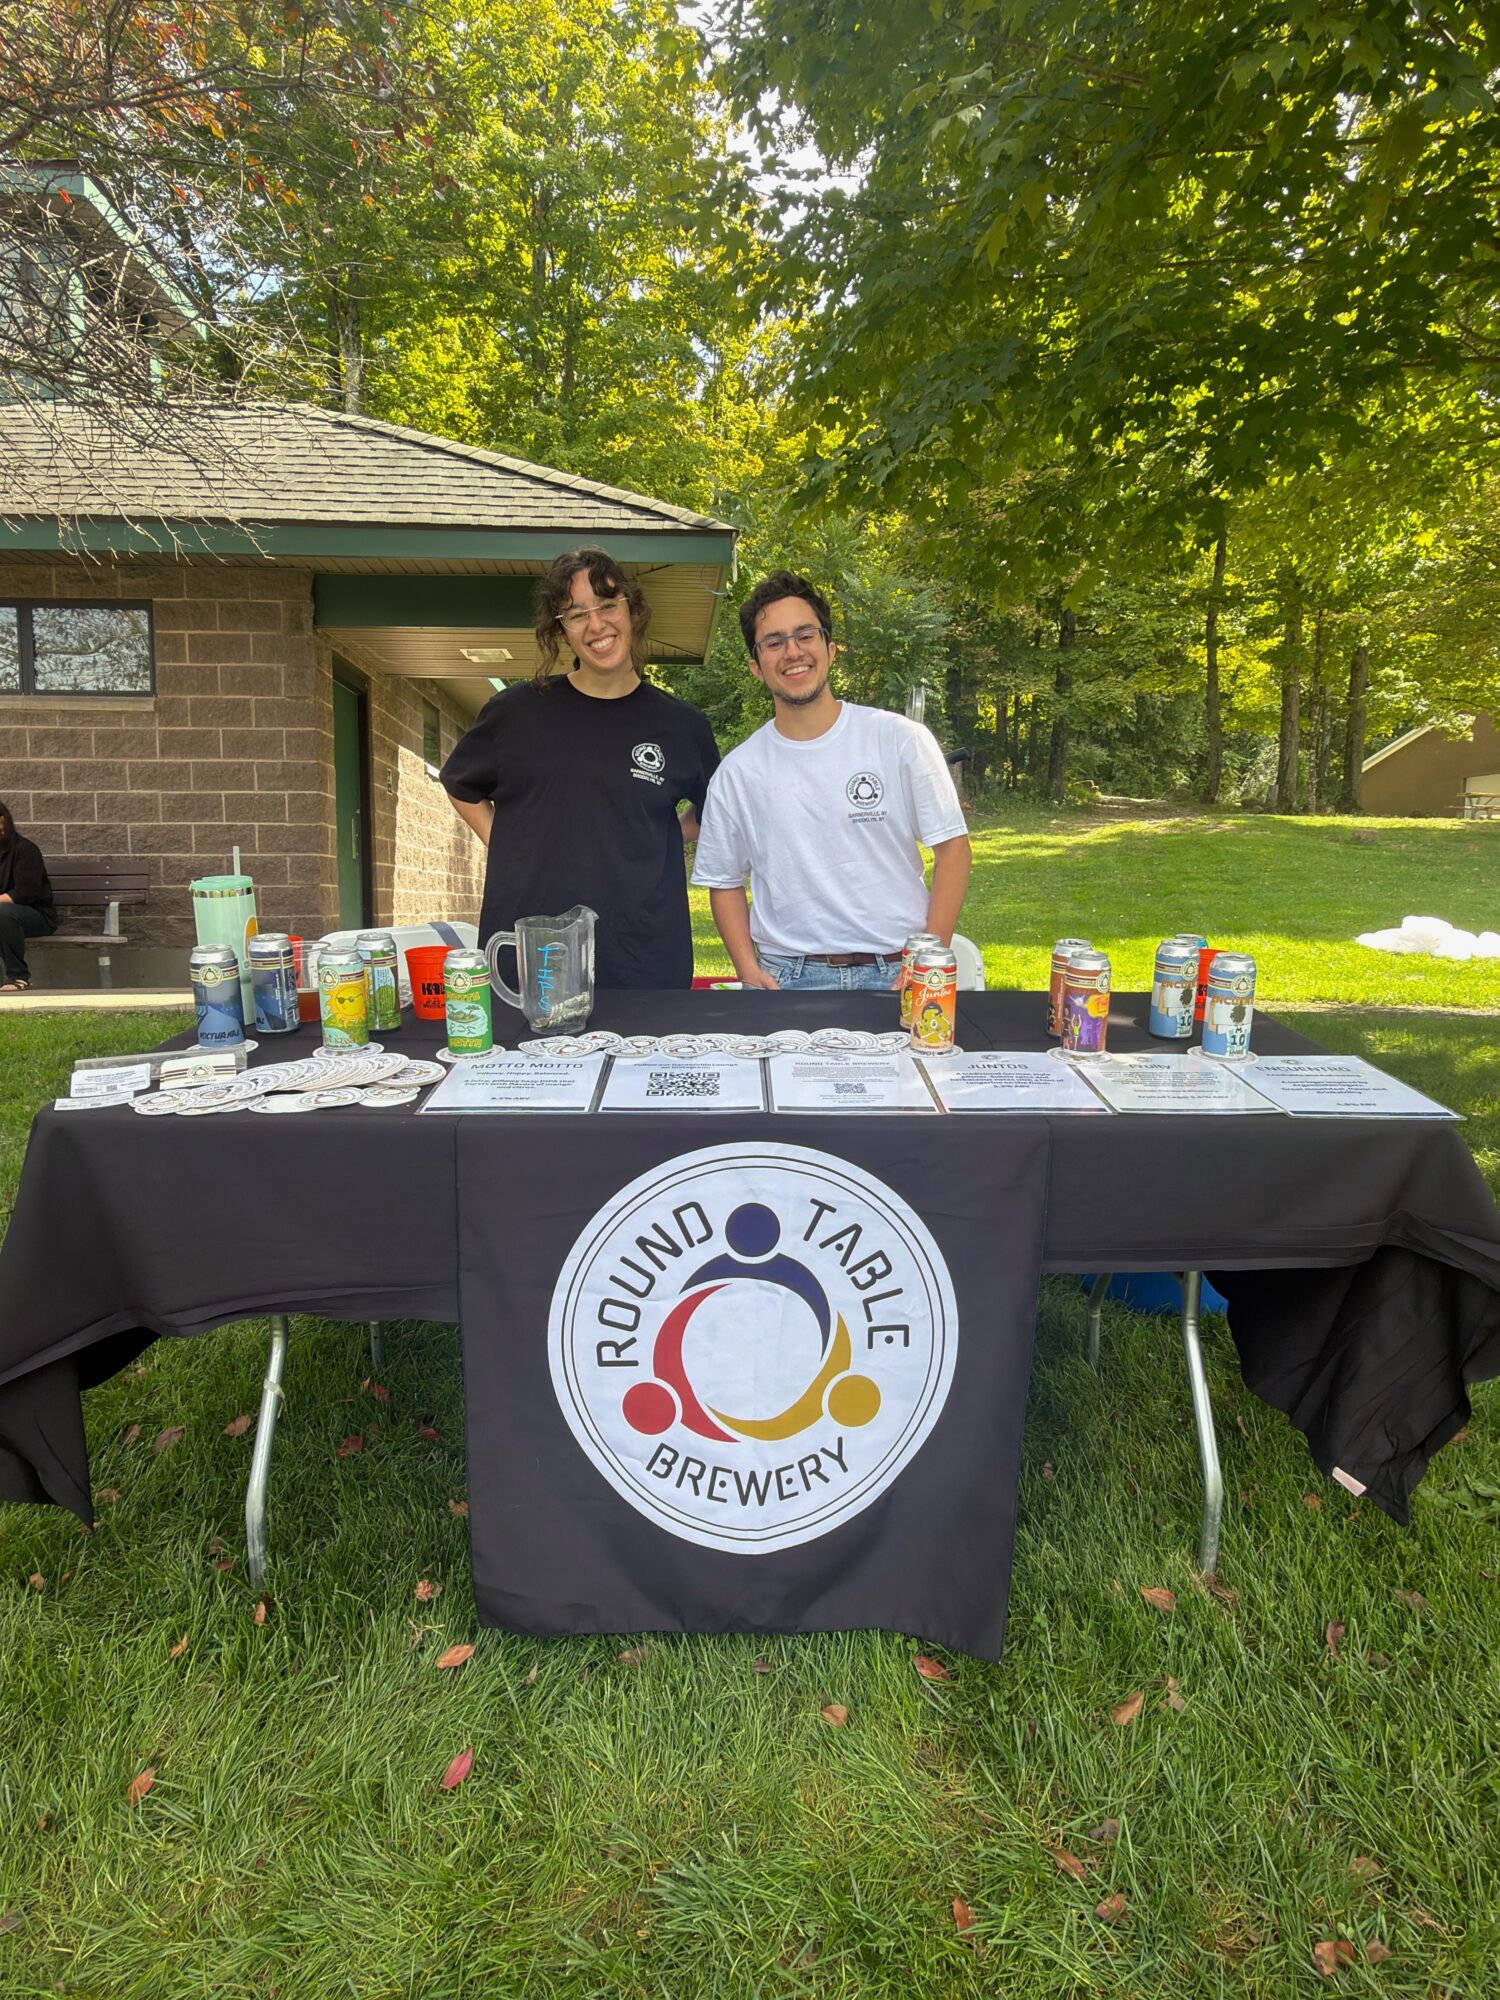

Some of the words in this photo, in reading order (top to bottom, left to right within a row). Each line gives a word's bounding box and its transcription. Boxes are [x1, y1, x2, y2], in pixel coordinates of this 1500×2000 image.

[1230, 1034, 1245, 1046] 10
[596, 1201, 714, 1367] ROUND
[803, 1198, 910, 1350] TABLE
[645, 1436, 849, 1507] BREWERY
